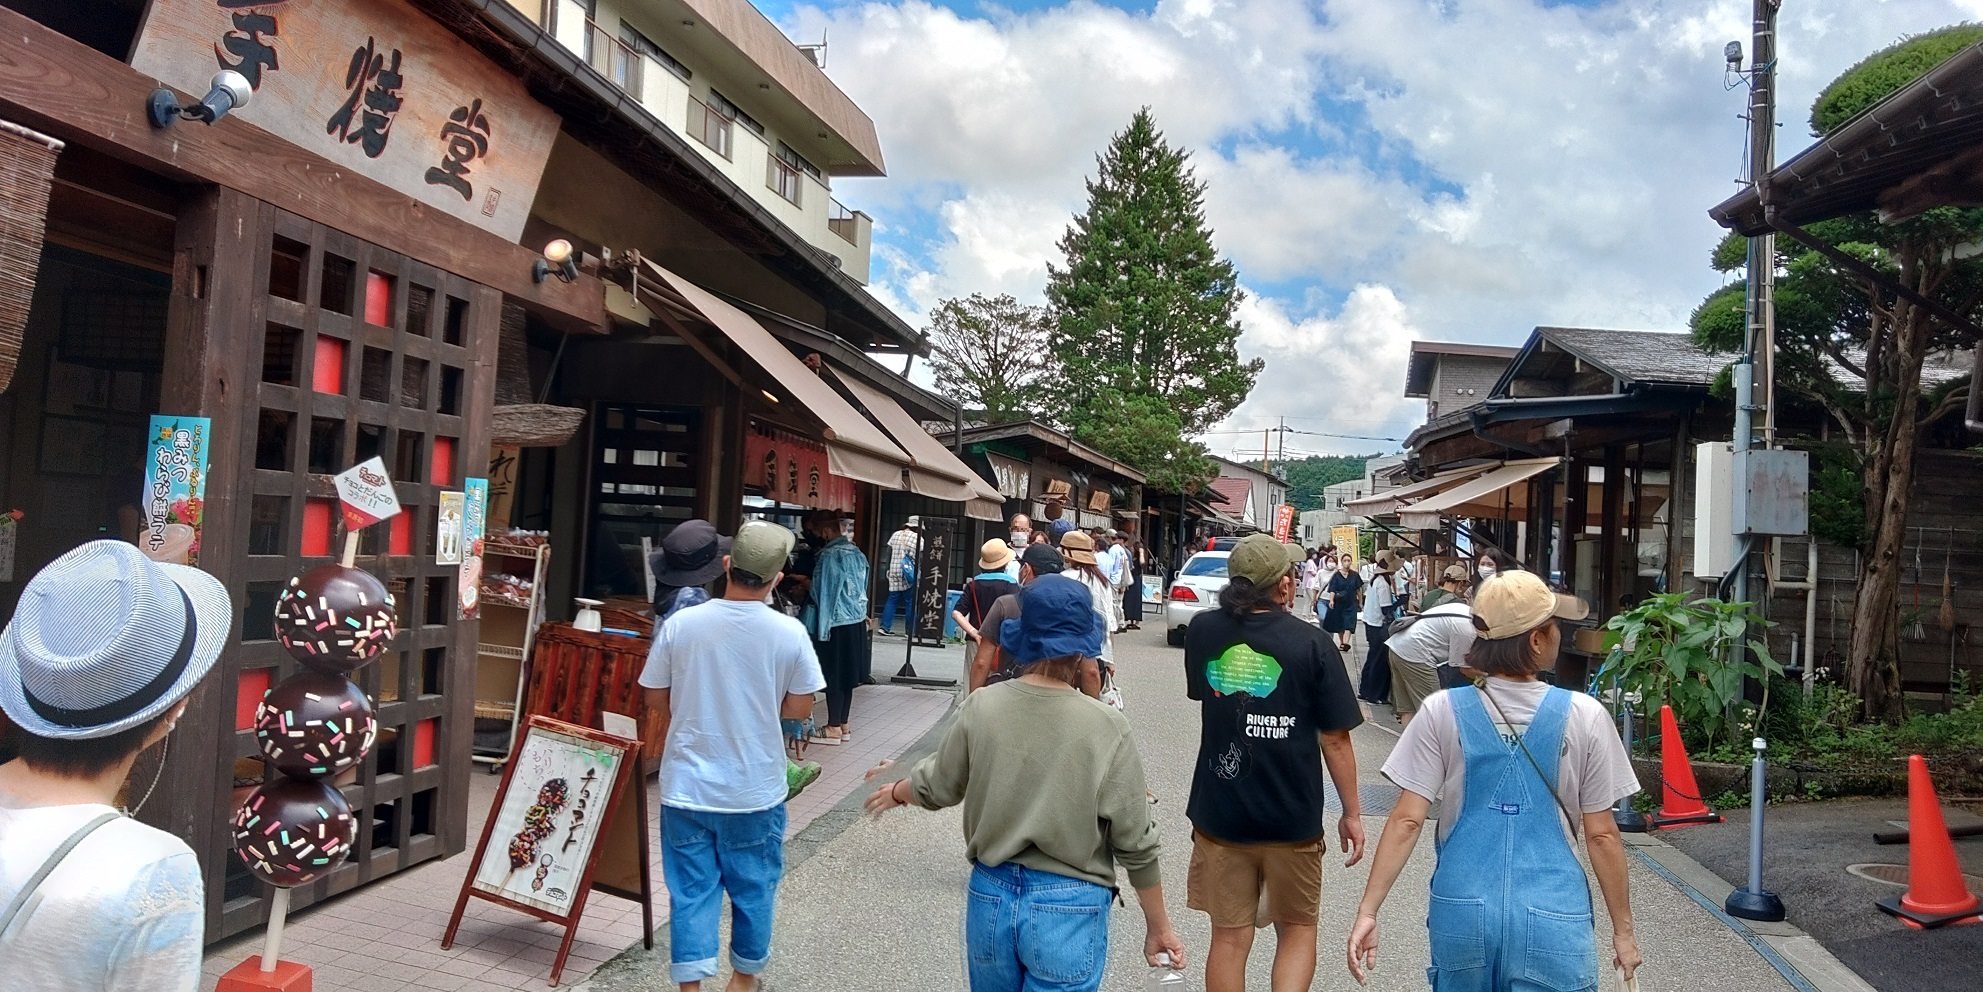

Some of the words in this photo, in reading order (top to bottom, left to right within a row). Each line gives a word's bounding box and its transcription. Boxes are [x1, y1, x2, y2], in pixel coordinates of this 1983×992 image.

[171, 429, 191, 482] 黒みつ
[149, 446, 172, 552] わらび餅ラテ
[343, 476, 393, 505] チョコとだんごの
[929, 535, 945, 561] 煎餅
[920, 565, 943, 630] 手焼堂
[1245, 726, 1290, 739] CULTURE
[1247, 713, 1278, 727] RIVER
[1279, 716, 1296, 727] SIDE
[562, 767, 598, 853] チョコマント
